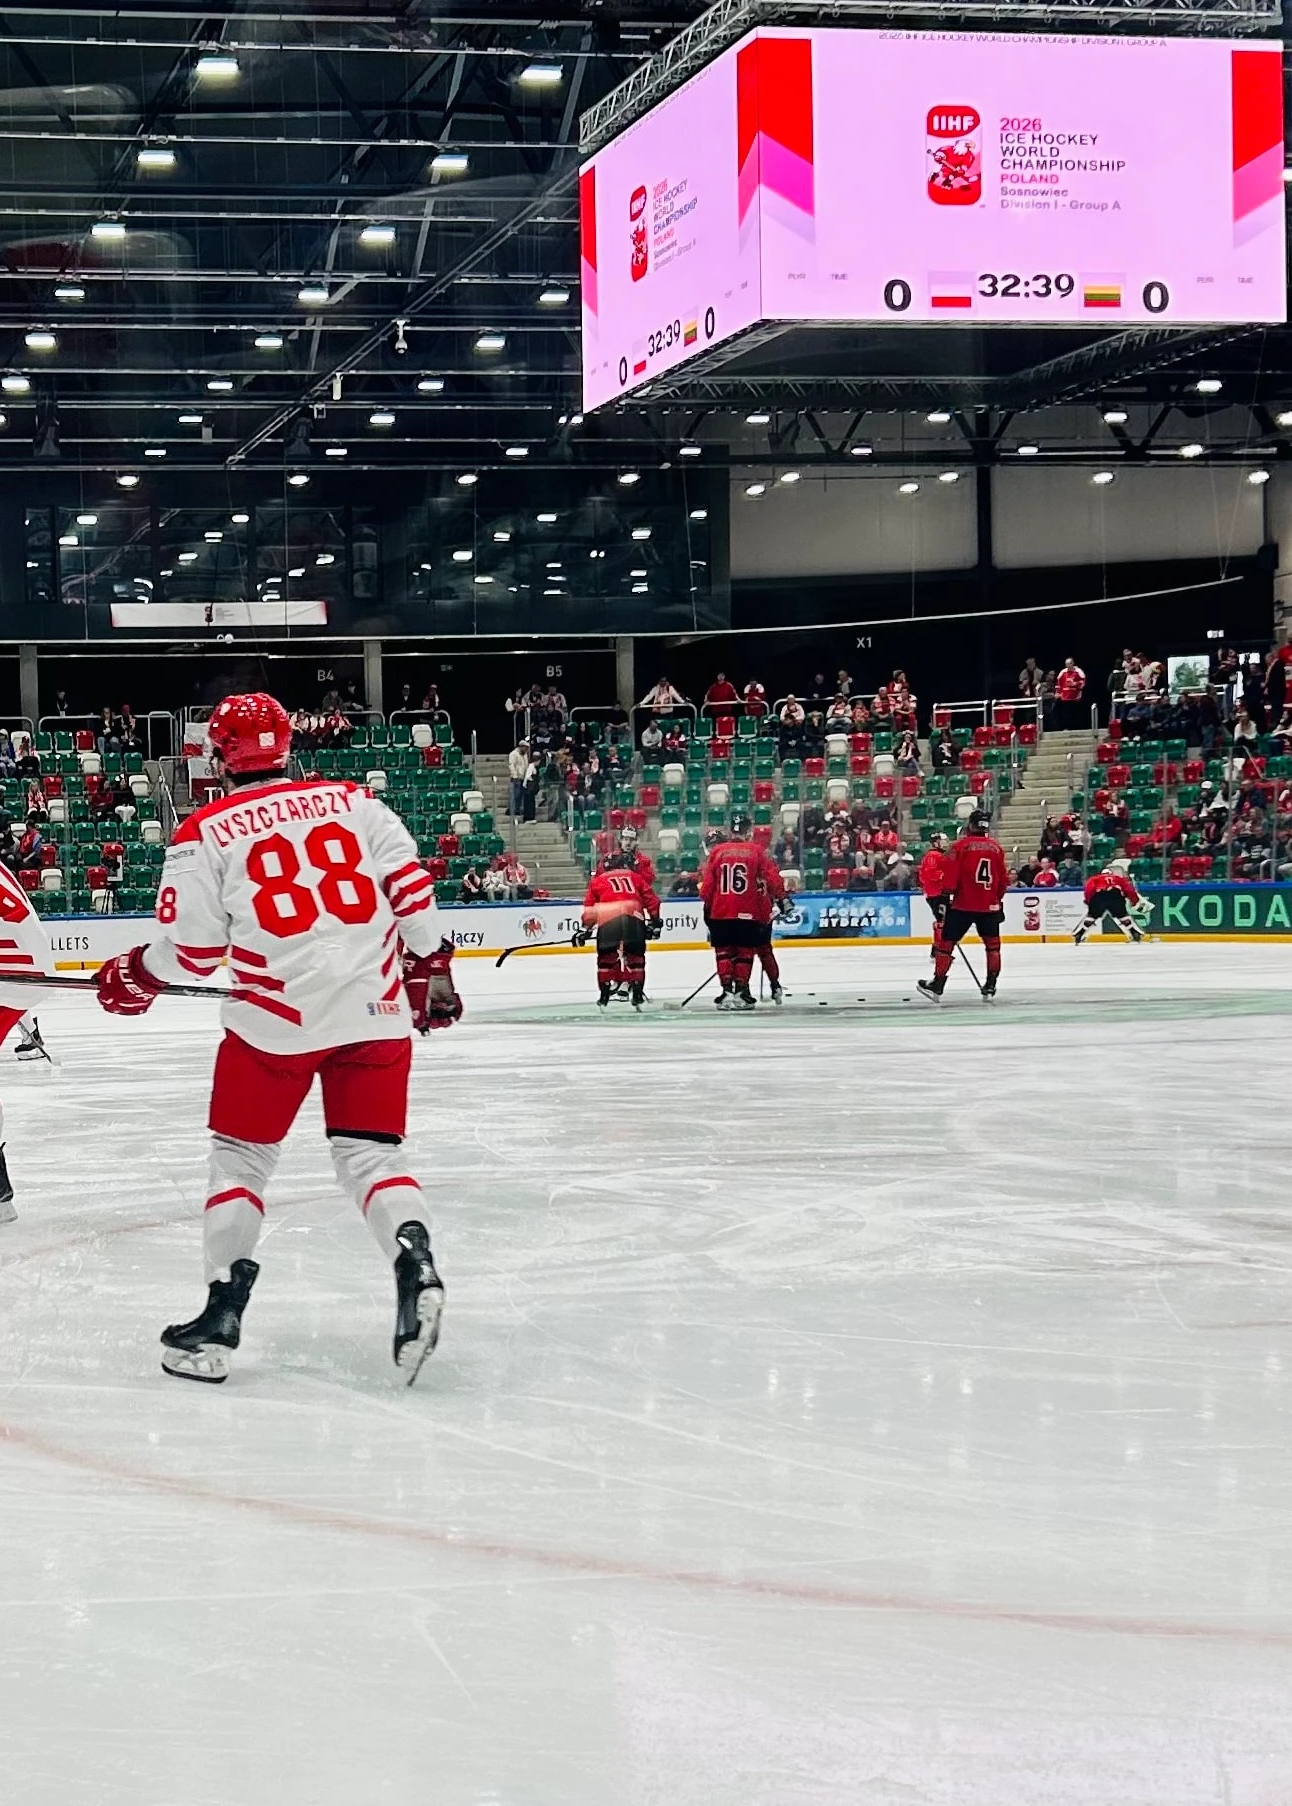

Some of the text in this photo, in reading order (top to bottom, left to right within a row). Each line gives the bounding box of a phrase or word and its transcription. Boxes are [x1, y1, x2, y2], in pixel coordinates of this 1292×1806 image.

[932, 115, 975, 131] IIHF
[1000, 117, 1042, 132] 2026
[1000, 132, 1099, 146] ICE HOCKEY
[1000, 146, 1060, 158] WORLD
[1000, 158, 1126, 172] CHAMPIONSHIP
[1000, 173, 1060, 184] POLAND
[1000, 186, 1069, 197] Sosnowiec
[1000, 199, 1051, 210] Division
[1069, 200, 1109, 212] Group
[1111, 200, 1122, 210] A
[883, 272, 1170, 314] 0 32:39 0
[619, 356, 628, 387] 0
[647, 319, 681, 358] 32:39
[704, 306, 715, 340] 0
[856, 637, 873, 648] X1
[317, 669, 334, 682] B4
[546, 665, 563, 677] B5
[245, 820, 378, 939] 88
[720, 862, 749, 895] 16
[975, 858, 993, 891] 4
[608, 876, 636, 894] 11
[819, 907, 876, 918] SPORTS
[819, 916, 907, 928] HYDRATION
[450, 929, 485, 947] łączy
